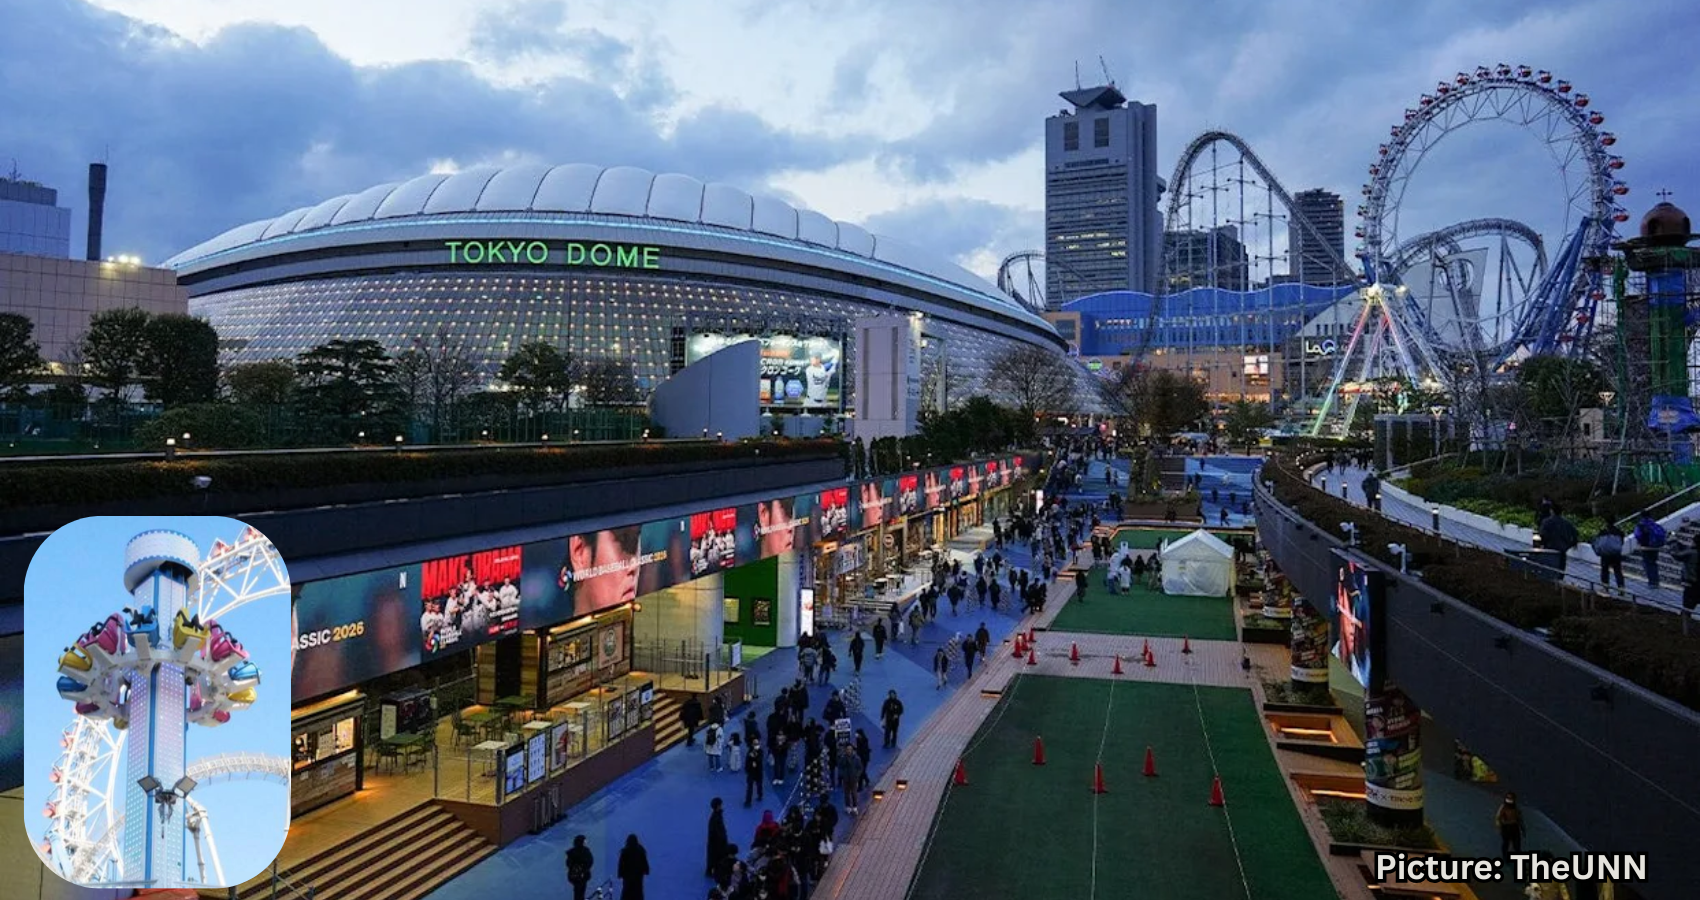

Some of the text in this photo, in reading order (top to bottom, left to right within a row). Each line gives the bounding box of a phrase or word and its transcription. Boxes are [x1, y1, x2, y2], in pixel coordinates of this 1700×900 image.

[445, 241, 660, 269] TOKYO DOME
[332, 621, 365, 642] 2026
